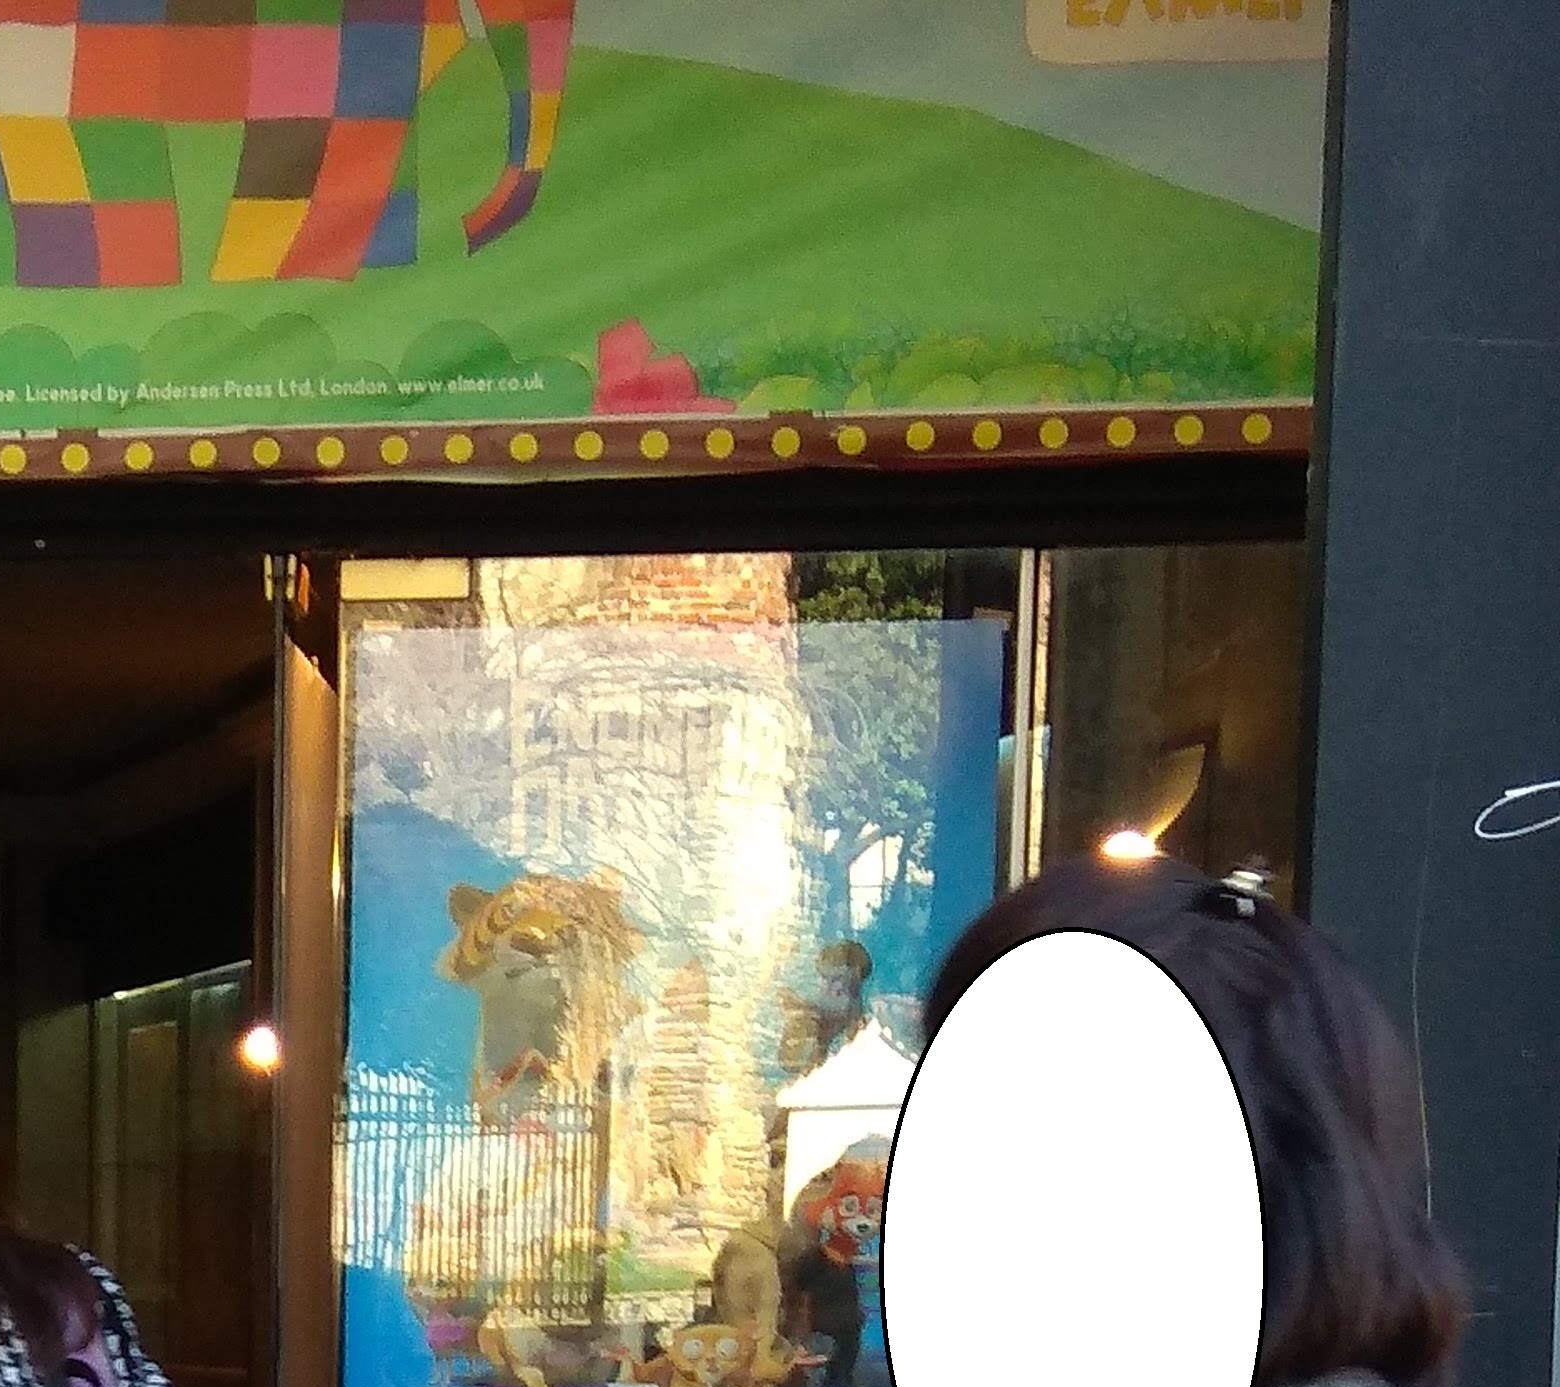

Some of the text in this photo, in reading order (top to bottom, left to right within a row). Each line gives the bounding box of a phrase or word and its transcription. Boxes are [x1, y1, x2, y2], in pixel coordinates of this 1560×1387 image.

[26, 382, 102, 402] Licensed
[108, 384, 130, 408] by
[224, 379, 272, 398] Press
